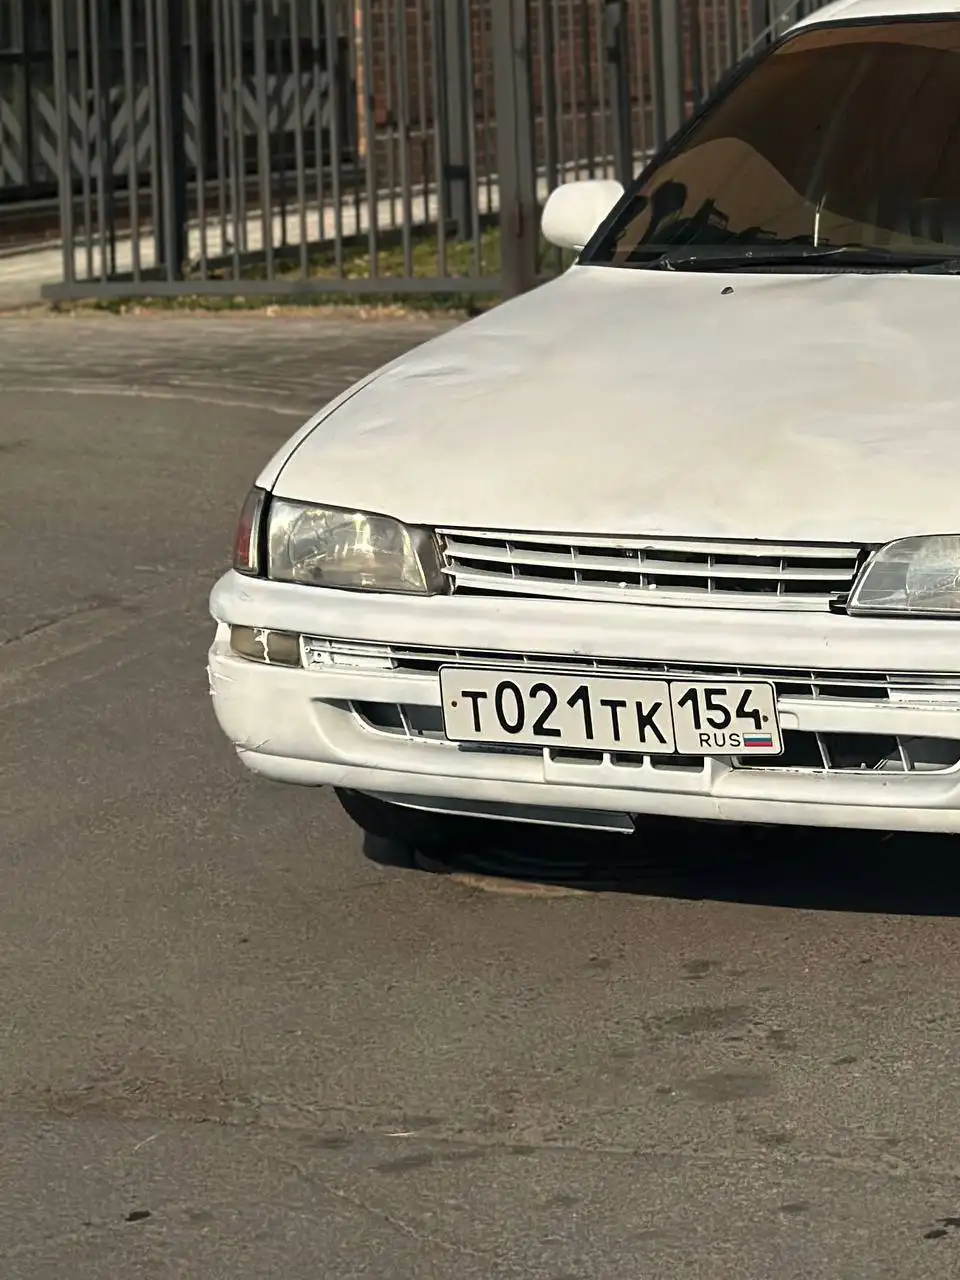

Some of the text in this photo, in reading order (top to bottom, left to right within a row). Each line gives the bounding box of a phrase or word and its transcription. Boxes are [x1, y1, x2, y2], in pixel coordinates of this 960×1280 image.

[461, 680, 763, 744] Т021ТК 154
[699, 732, 741, 747] RUS
